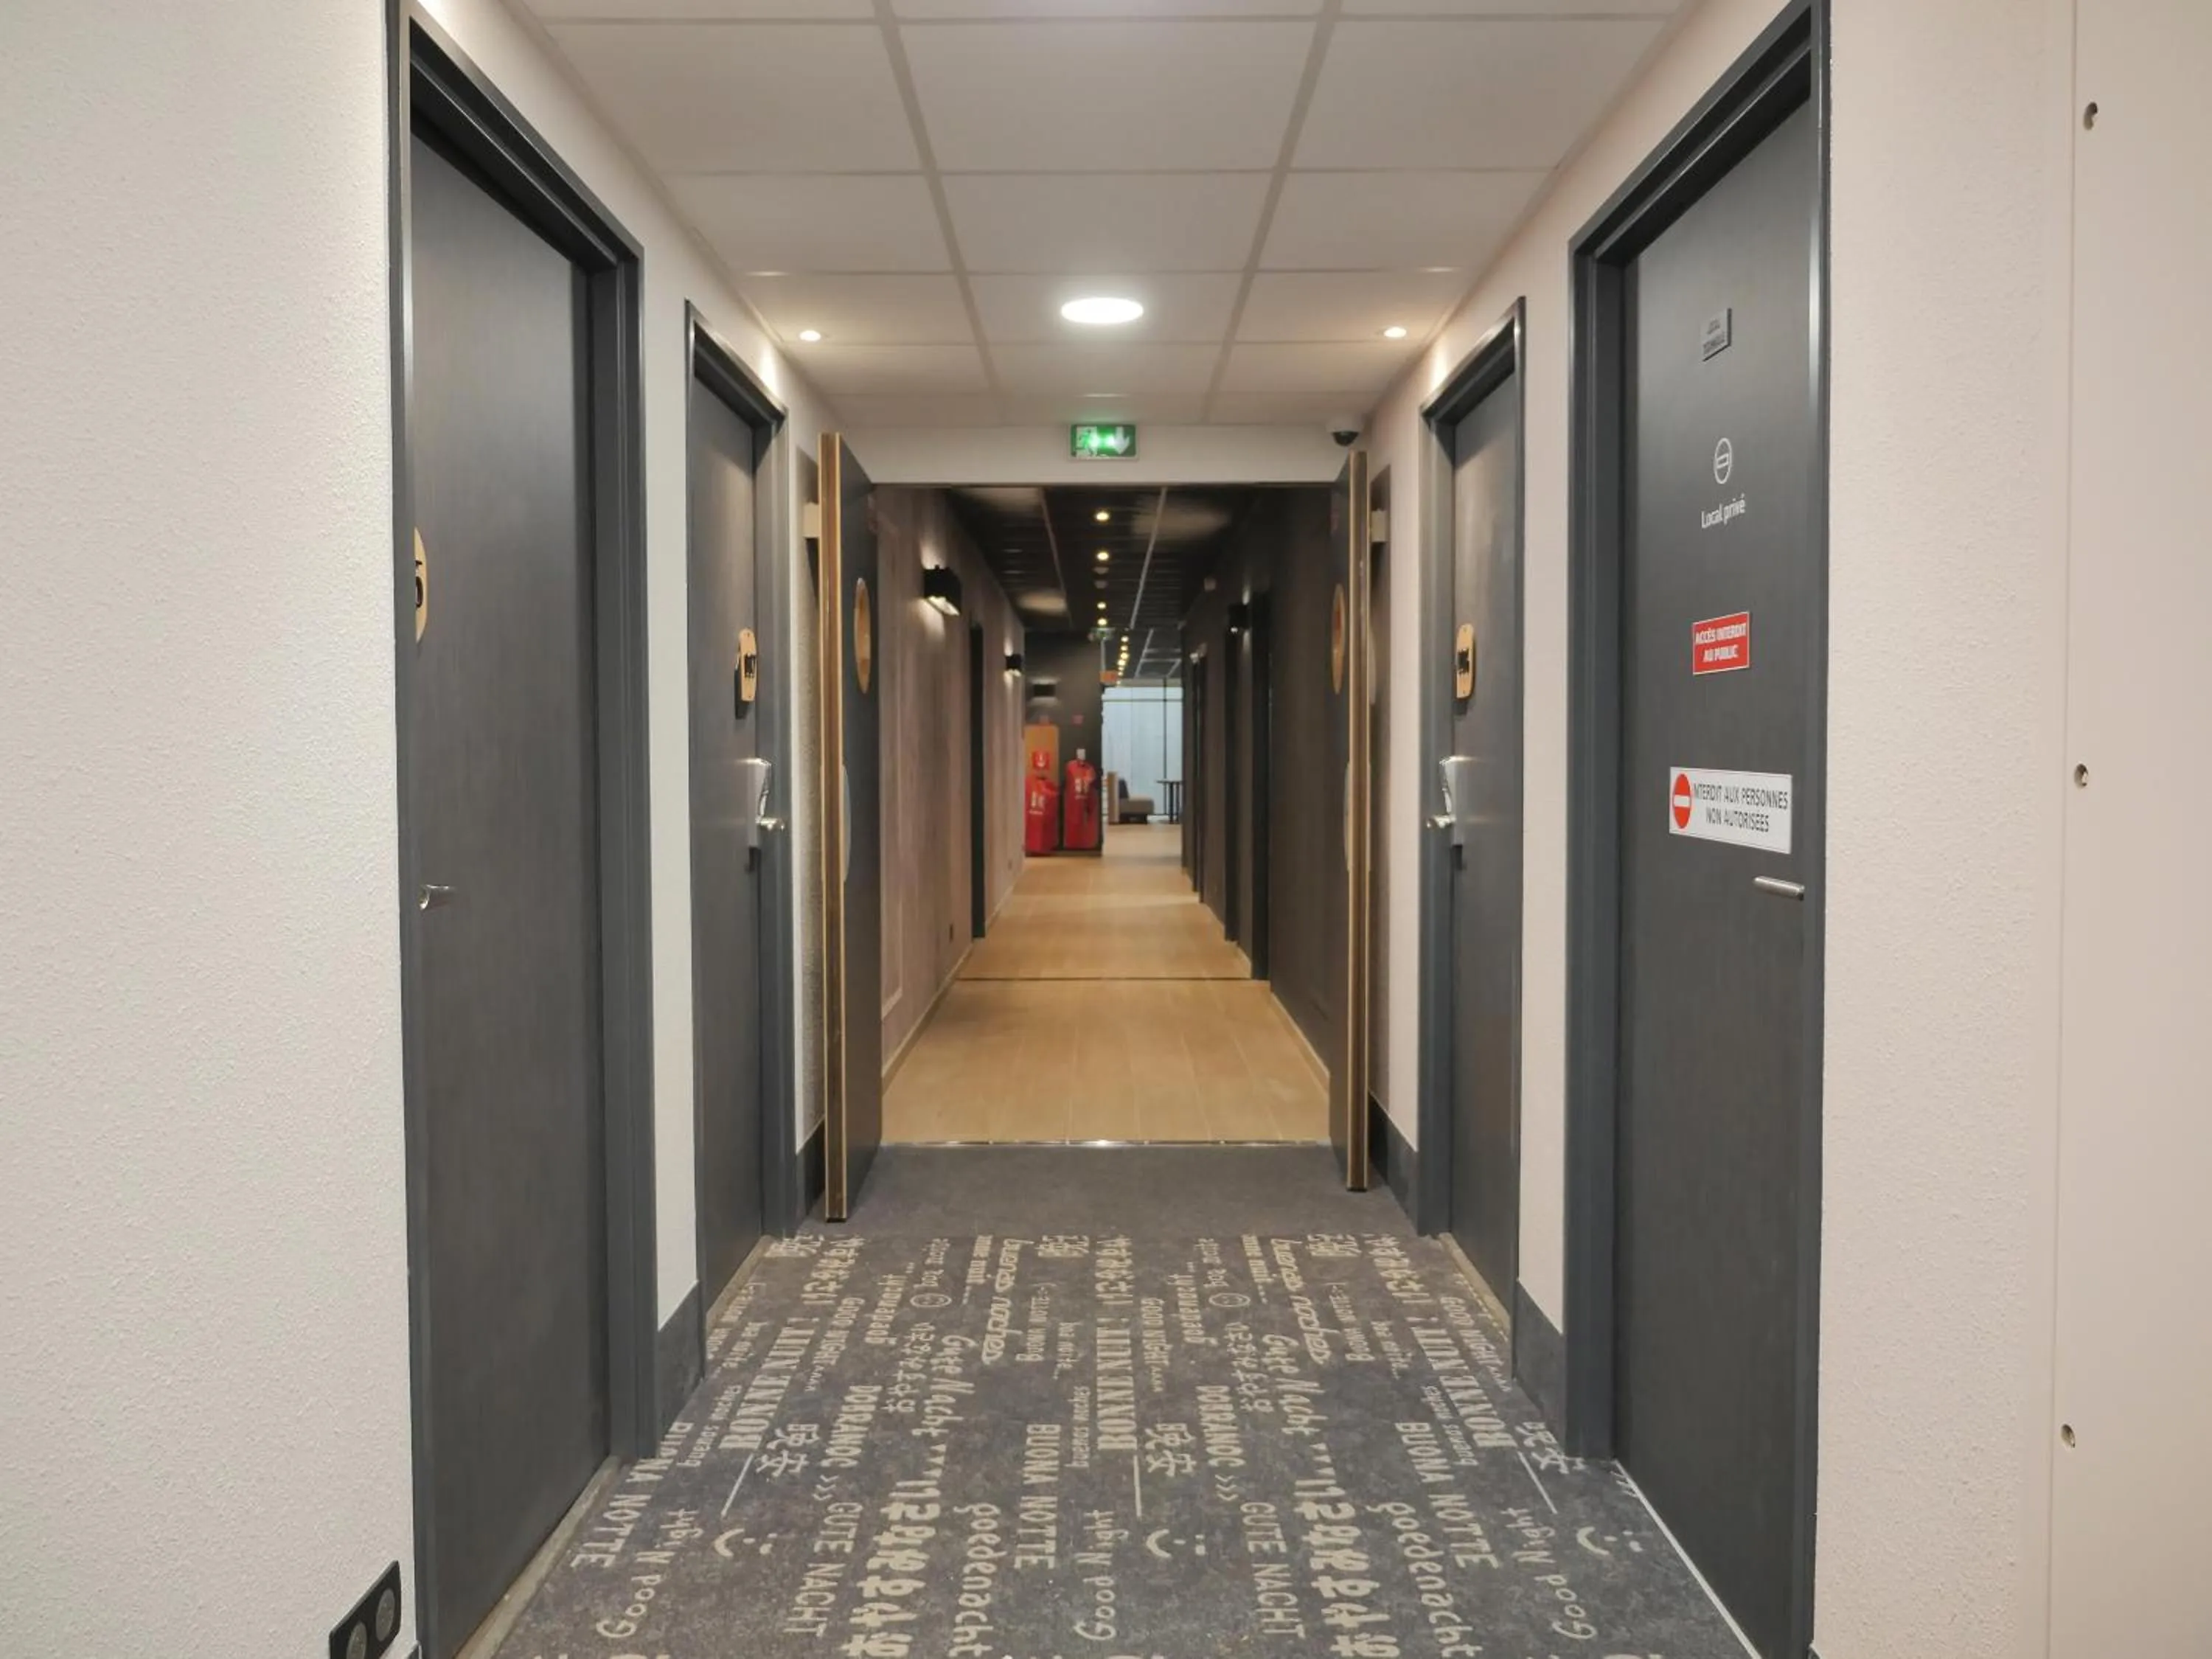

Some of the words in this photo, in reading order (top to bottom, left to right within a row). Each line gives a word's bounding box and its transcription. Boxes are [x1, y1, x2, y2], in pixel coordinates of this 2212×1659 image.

[1702, 503, 1723, 529] Local
[1724, 493, 1745, 526] privé
[1703, 648, 1714, 662] AU
[1714, 644, 1739, 661] PUBLIC
[1716, 622, 1747, 641] INTERDIT
[1705, 807, 1722, 825] NON
[1724, 786, 1739, 804] AUX
[1741, 787, 1789, 810] PERSONNES
[830, 1297, 865, 1326] GOOD
[1140, 1297, 1164, 1326] GOOD
[930, 1335, 978, 1374] Gute
[1262, 1334, 1299, 1374] Gute
[703, 1375, 790, 1450] BONNE
[821, 1385, 881, 1467] DOBRANOC
[911, 1378, 974, 1436] Nacht
[1096, 1376, 1137, 1450] BONNE
[1197, 1385, 1244, 1467] DOBRANOC
[1276, 1378, 1326, 1435] Nacht
[1439, 1375, 1516, 1447] BONNE
[1023, 1424, 1060, 1484] BUONA
[1395, 1422, 1453, 1482] BUONA
[1430, 1494, 1499, 1567] NOTTE
[571, 1494, 650, 1567] NOTTE
[813, 1502, 863, 1552] GUTE
[1014, 1496, 1057, 1568] NOTTE
[1074, 1510, 1129, 1565] Night
[1240, 1502, 1287, 1553] GUTE
[1500, 1508, 1555, 1563] Night
[595, 1574, 662, 1638] Good
[636, 1509, 703, 1563] Night
[785, 1563, 844, 1636] NACHT
[949, 1503, 1006, 1656] goedenacht
[1253, 1563, 1305, 1638] NACHT
[1367, 1502, 1481, 1657] goedenacht
[1073, 1576, 1116, 1641] Good
[1534, 1574, 1596, 1639] Good
